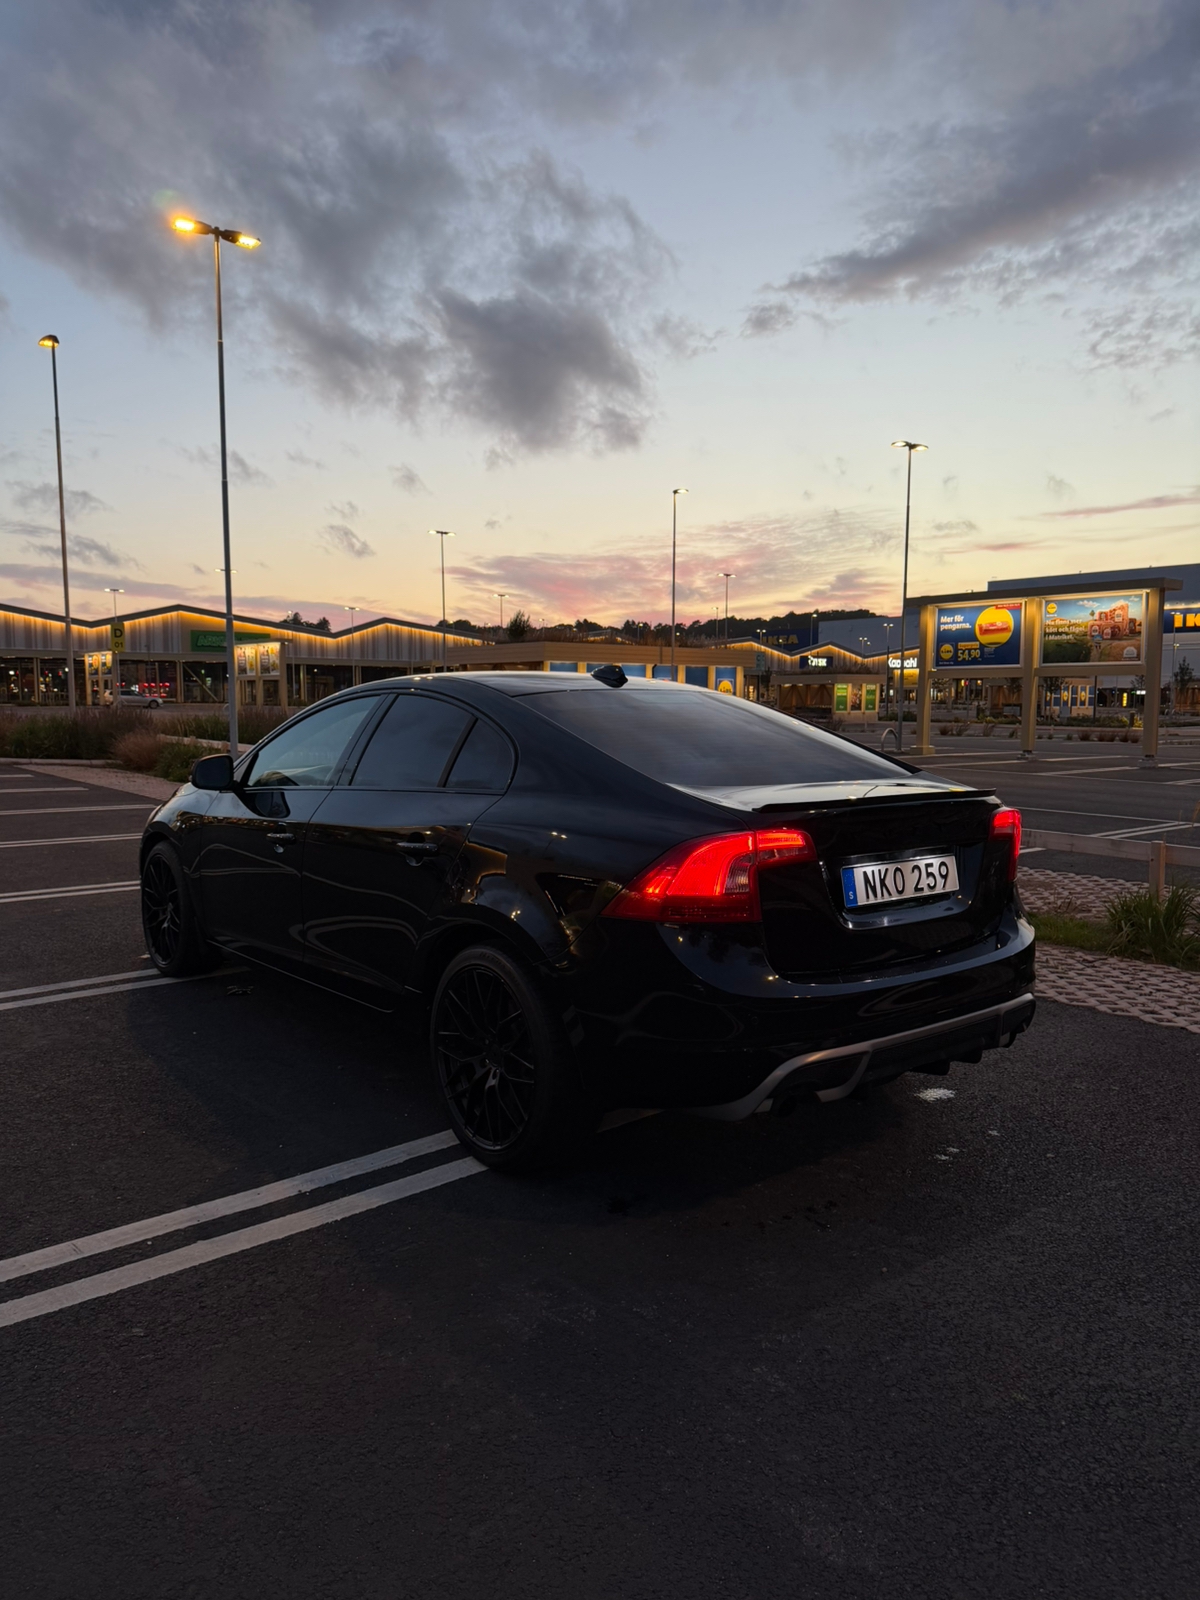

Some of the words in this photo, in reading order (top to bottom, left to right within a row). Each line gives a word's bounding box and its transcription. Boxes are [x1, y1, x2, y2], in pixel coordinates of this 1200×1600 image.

[940, 616, 954, 624] Mer
[954, 614, 965, 623] för
[940, 622, 972, 632] pengarna.
[114, 628, 123, 638] D
[762, 634, 799, 645] IKEA
[957, 649, 981, 661] 54.90
[863, 866, 905, 900] NKO
[911, 861, 949, 893] 259
[849, 891, 854, 900] S
